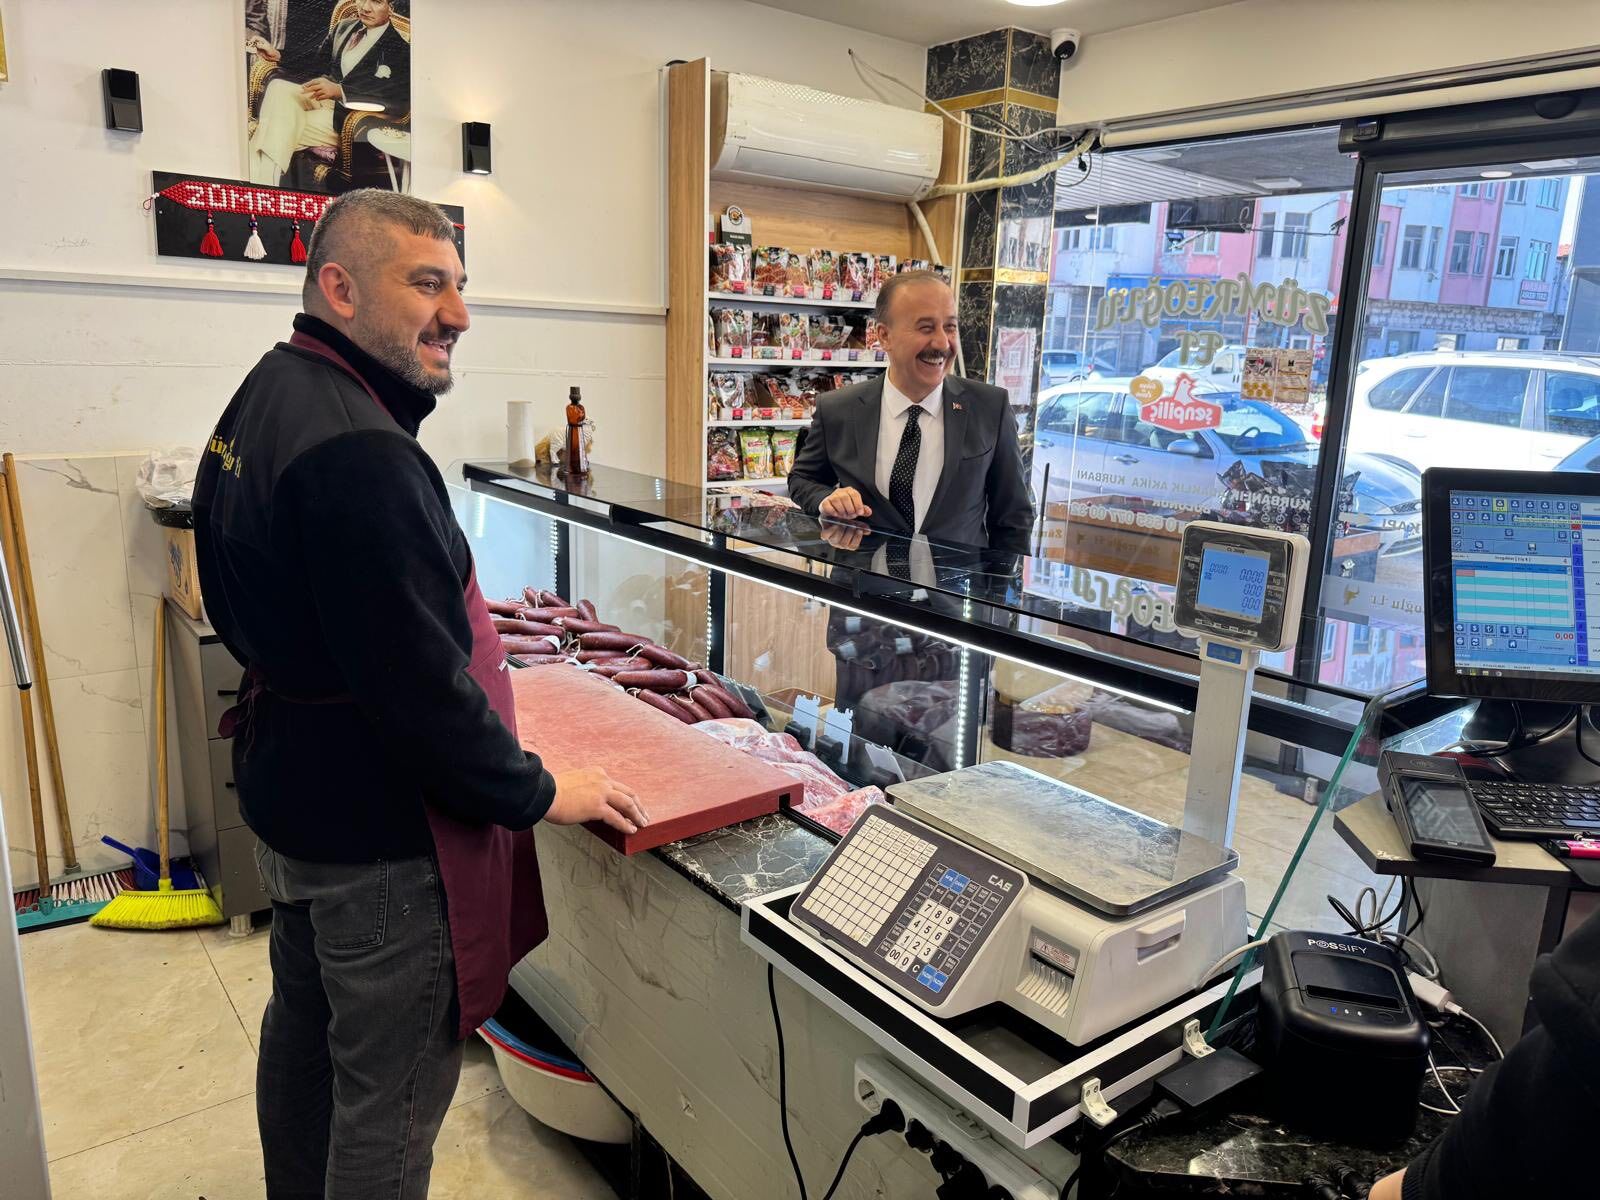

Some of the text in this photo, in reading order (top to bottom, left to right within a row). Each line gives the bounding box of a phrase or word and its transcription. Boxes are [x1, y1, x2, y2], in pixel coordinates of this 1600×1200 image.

[1555, 631, 1574, 641] 0,00
[988, 874, 1013, 893] CAS
[926, 904, 953, 925] 7 8 9
[913, 920, 942, 941] 4 5 6
[904, 935, 931, 956] 1 2 3
[1307, 939, 1367, 954] POSSIFY
[889, 949, 921, 973] 00 0 C
